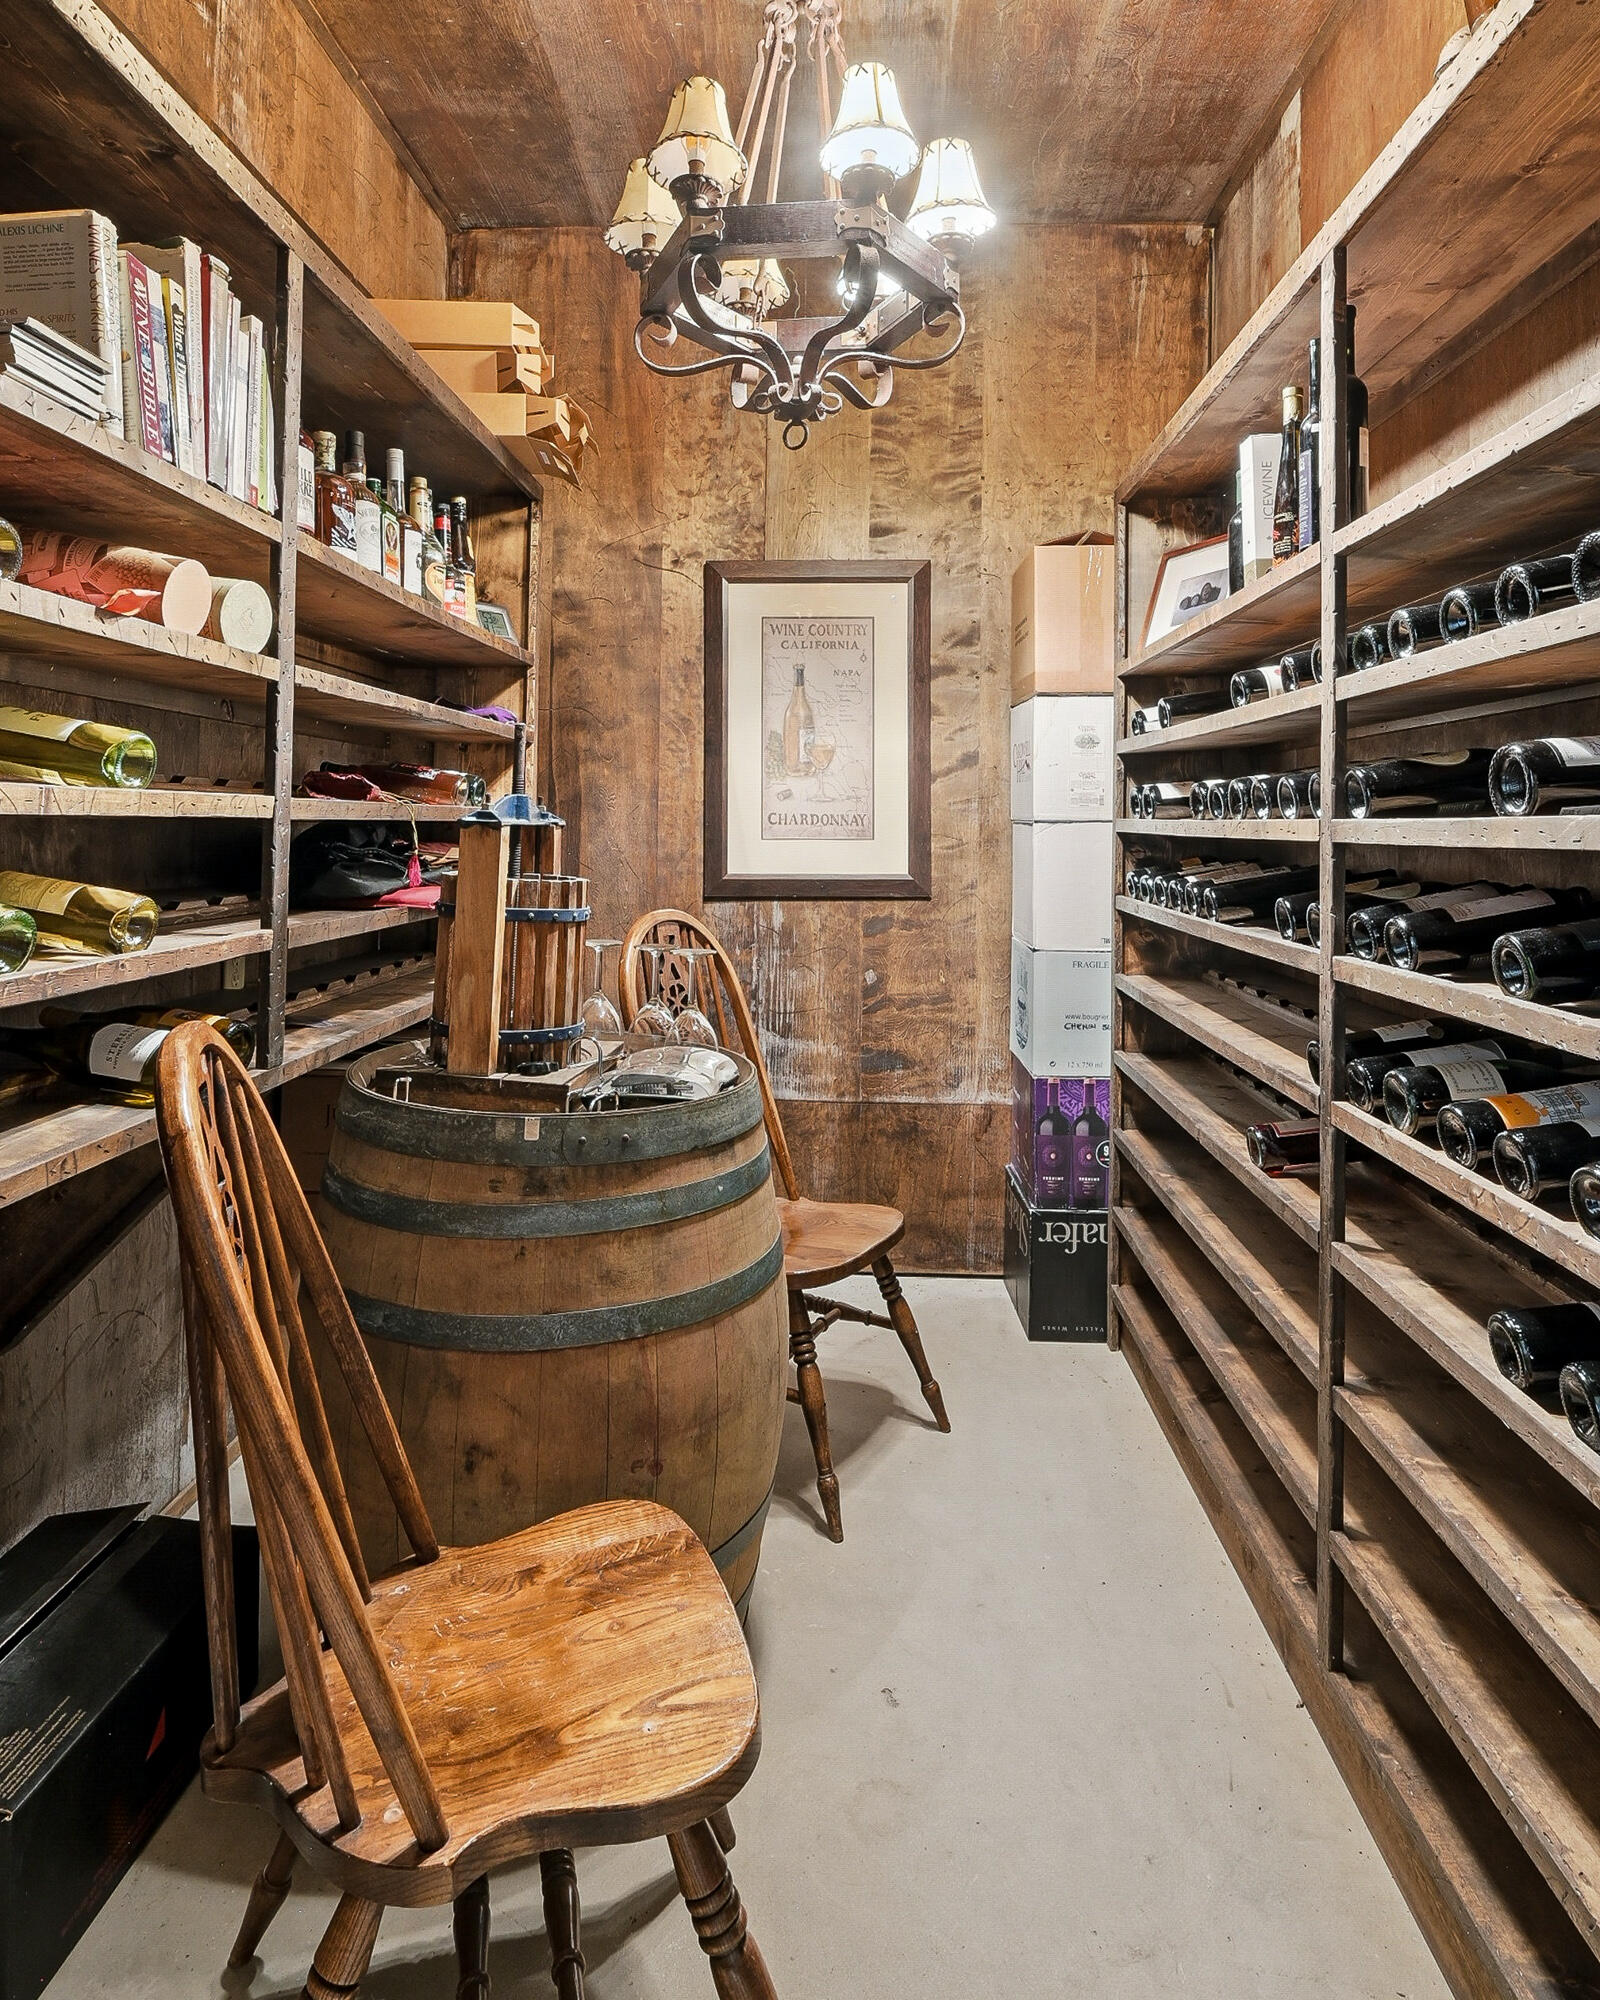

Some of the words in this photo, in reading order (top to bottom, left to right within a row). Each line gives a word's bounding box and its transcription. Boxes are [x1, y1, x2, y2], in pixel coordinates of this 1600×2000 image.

[0, 226, 25, 236] ALEXIS
[28, 223, 64, 234] LICHINE
[88, 224, 101, 274] WINES
[89, 279, 100, 292] &
[46, 313, 76, 323] SPIRITS
[90, 294, 105, 344] SPIRITS
[174, 313, 185, 351] Wine
[131, 278, 150, 350] WINE
[141, 362, 161, 441] BIBLE
[1262, 461, 1273, 520] ICEWINE
[769, 623, 804, 637] WINE
[808, 623, 868, 637] COUNTRY
[780, 640, 859, 650] CALIFORNIA
[833, 669, 862, 677] NAPA
[767, 812, 867, 827] CHARDONNAY
[1072, 960, 1109, 969] FRAGILE
[1063, 1022, 1096, 1031] CHENIN
